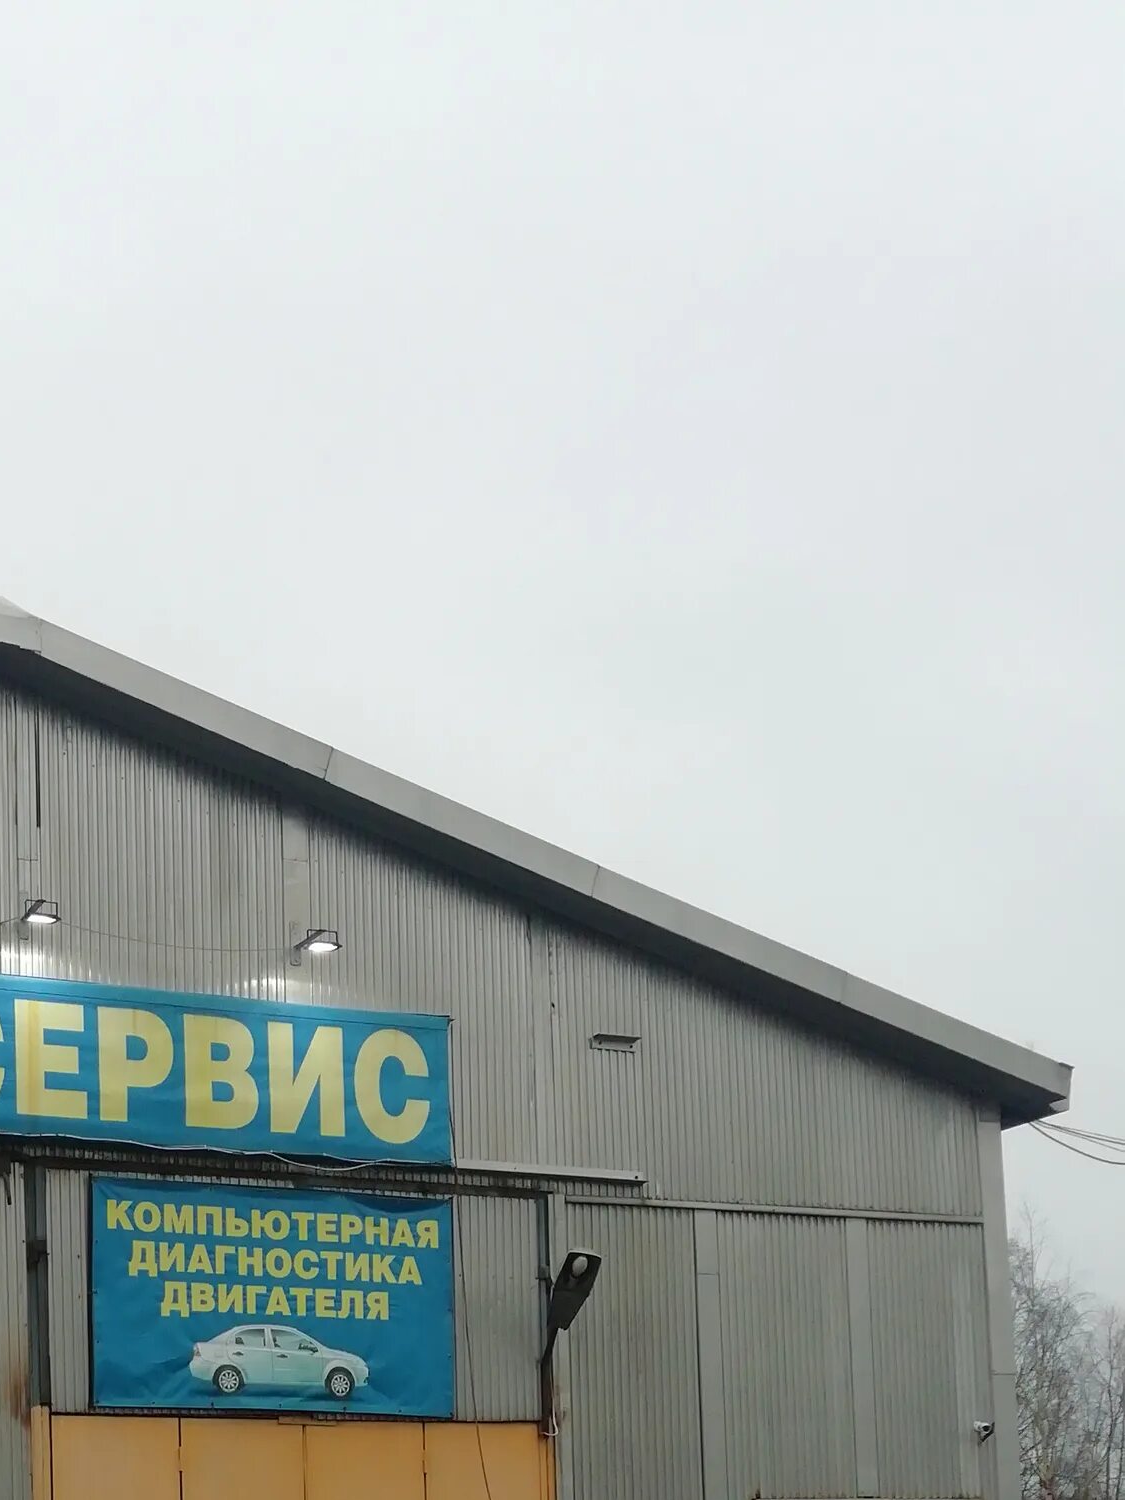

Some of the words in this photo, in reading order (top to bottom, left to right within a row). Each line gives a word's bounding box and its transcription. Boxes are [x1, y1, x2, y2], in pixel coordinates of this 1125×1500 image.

[106, 1198, 440, 1249] КОМПЬЮТЕРНАЯ
[128, 1239, 423, 1286] ДИАГНОСТИКА
[160, 1280, 390, 1321] ДВИГАТЕЛЯ
